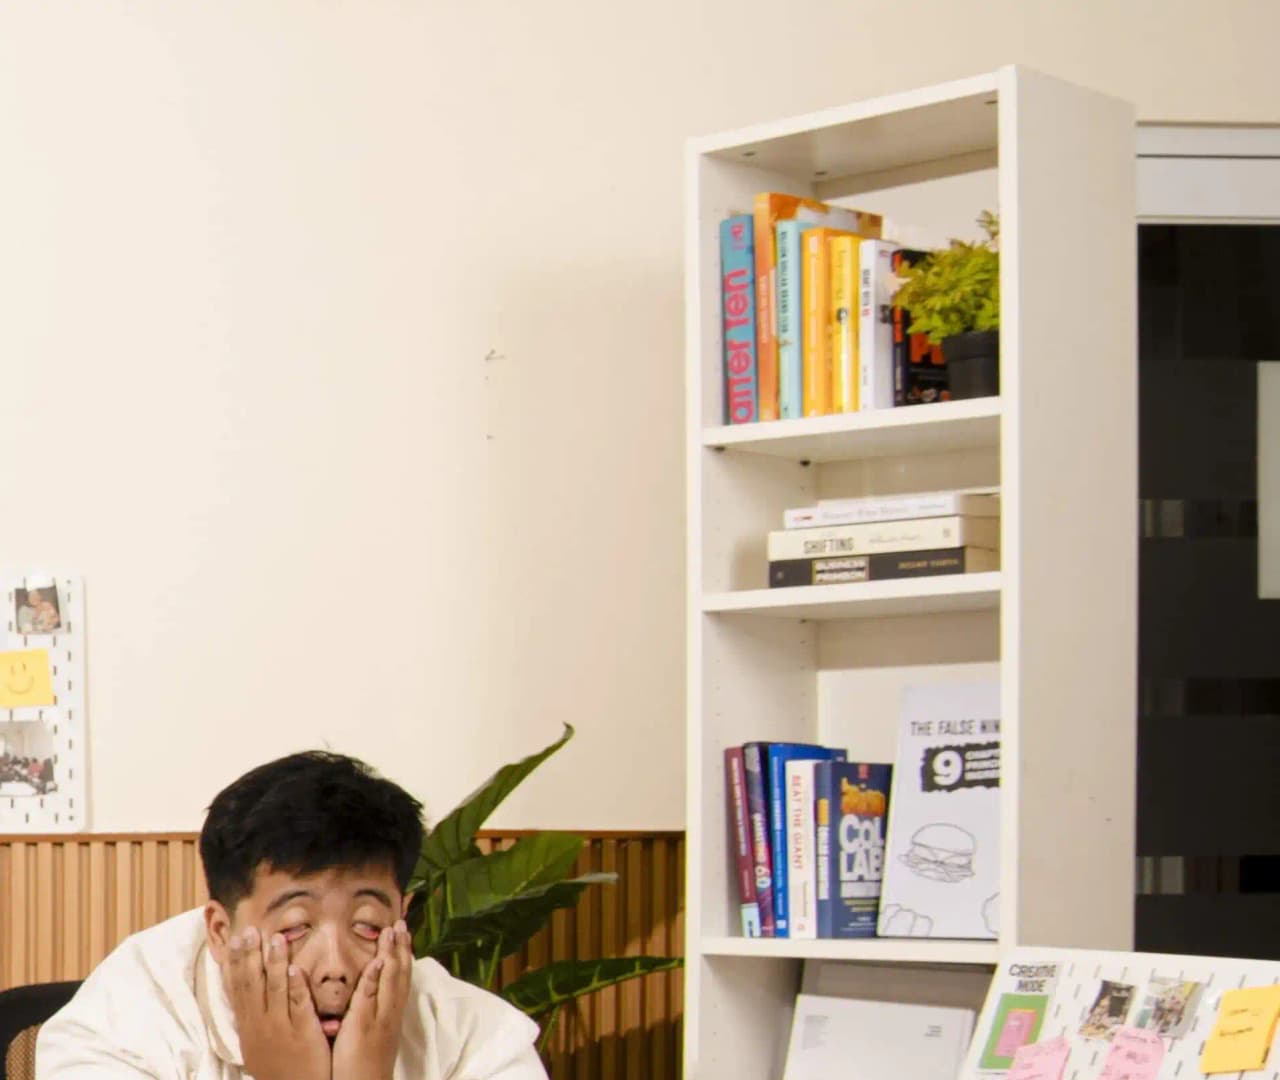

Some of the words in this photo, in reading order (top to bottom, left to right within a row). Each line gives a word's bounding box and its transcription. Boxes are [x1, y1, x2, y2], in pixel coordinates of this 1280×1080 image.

[803, 537, 854, 555] SHIFTING
[910, 720, 933, 737] THE
[937, 719, 975, 736] FALSE
[932, 750, 963, 786] 9
[792, 775, 802, 800] BEAT
[793, 807, 802, 828] THE
[793, 834, 803, 870] GIANT
